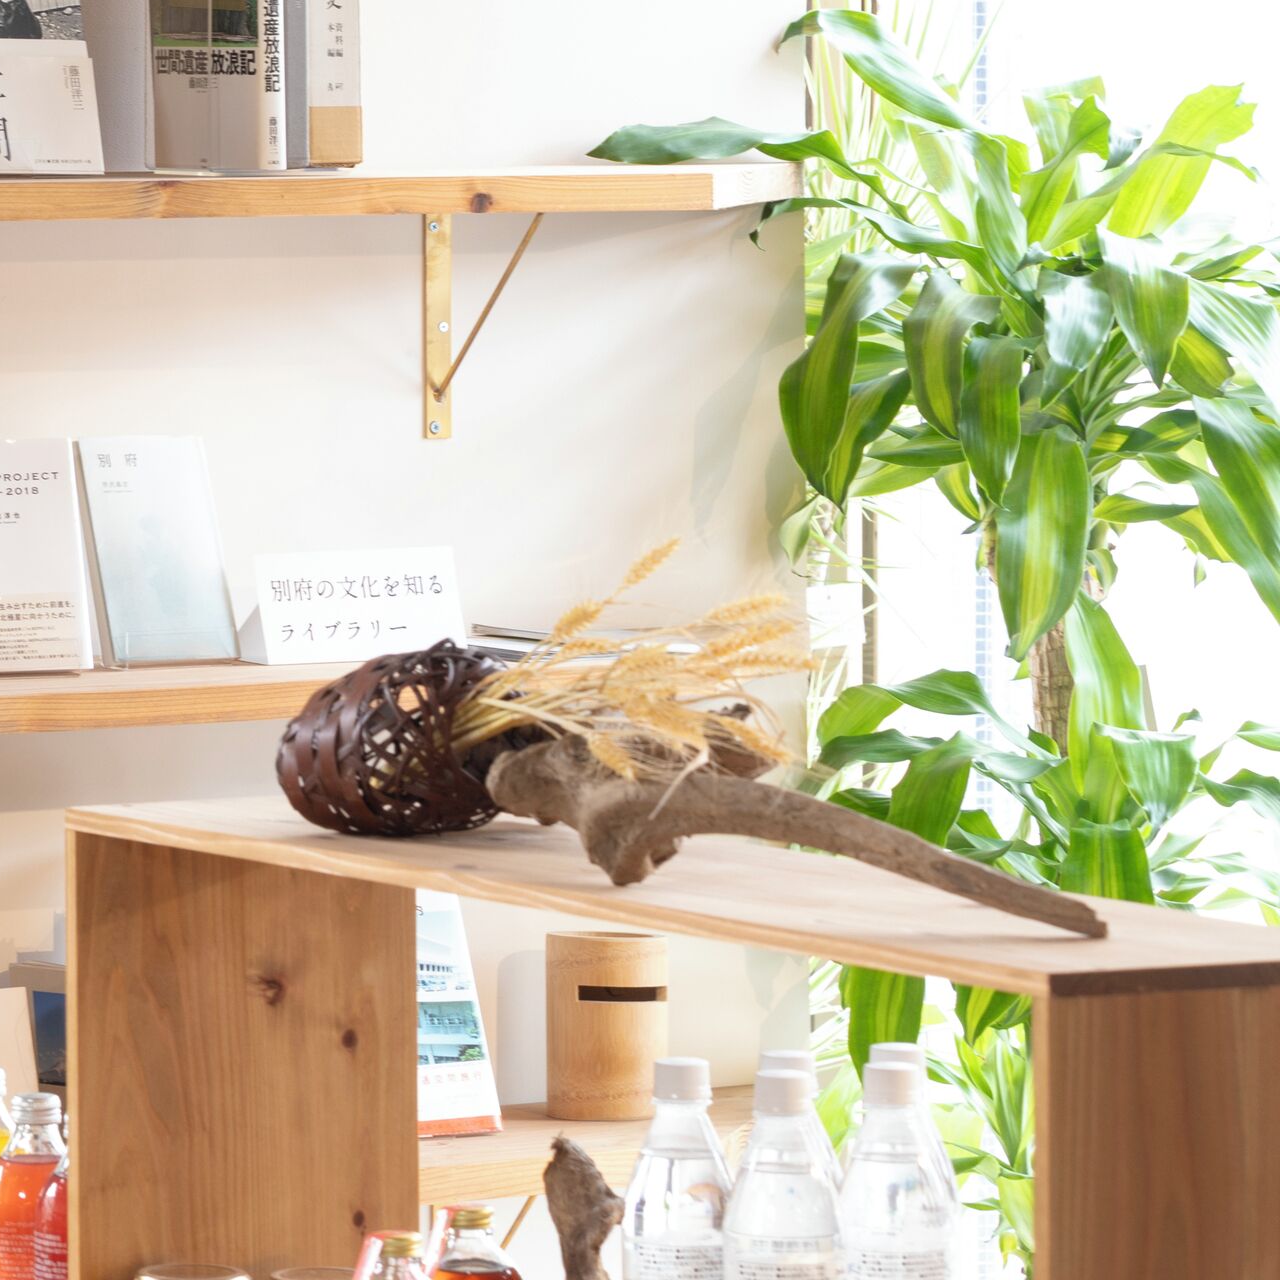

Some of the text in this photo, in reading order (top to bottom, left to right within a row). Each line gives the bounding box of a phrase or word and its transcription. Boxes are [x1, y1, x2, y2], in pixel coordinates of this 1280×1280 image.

[154, 48, 257, 76] 世間遺産放浪記
[97, 453, 138, 468] 別府
[270, 574, 444, 602] 別府の文化を知る
[281, 620, 408, 642] ライブラリー
